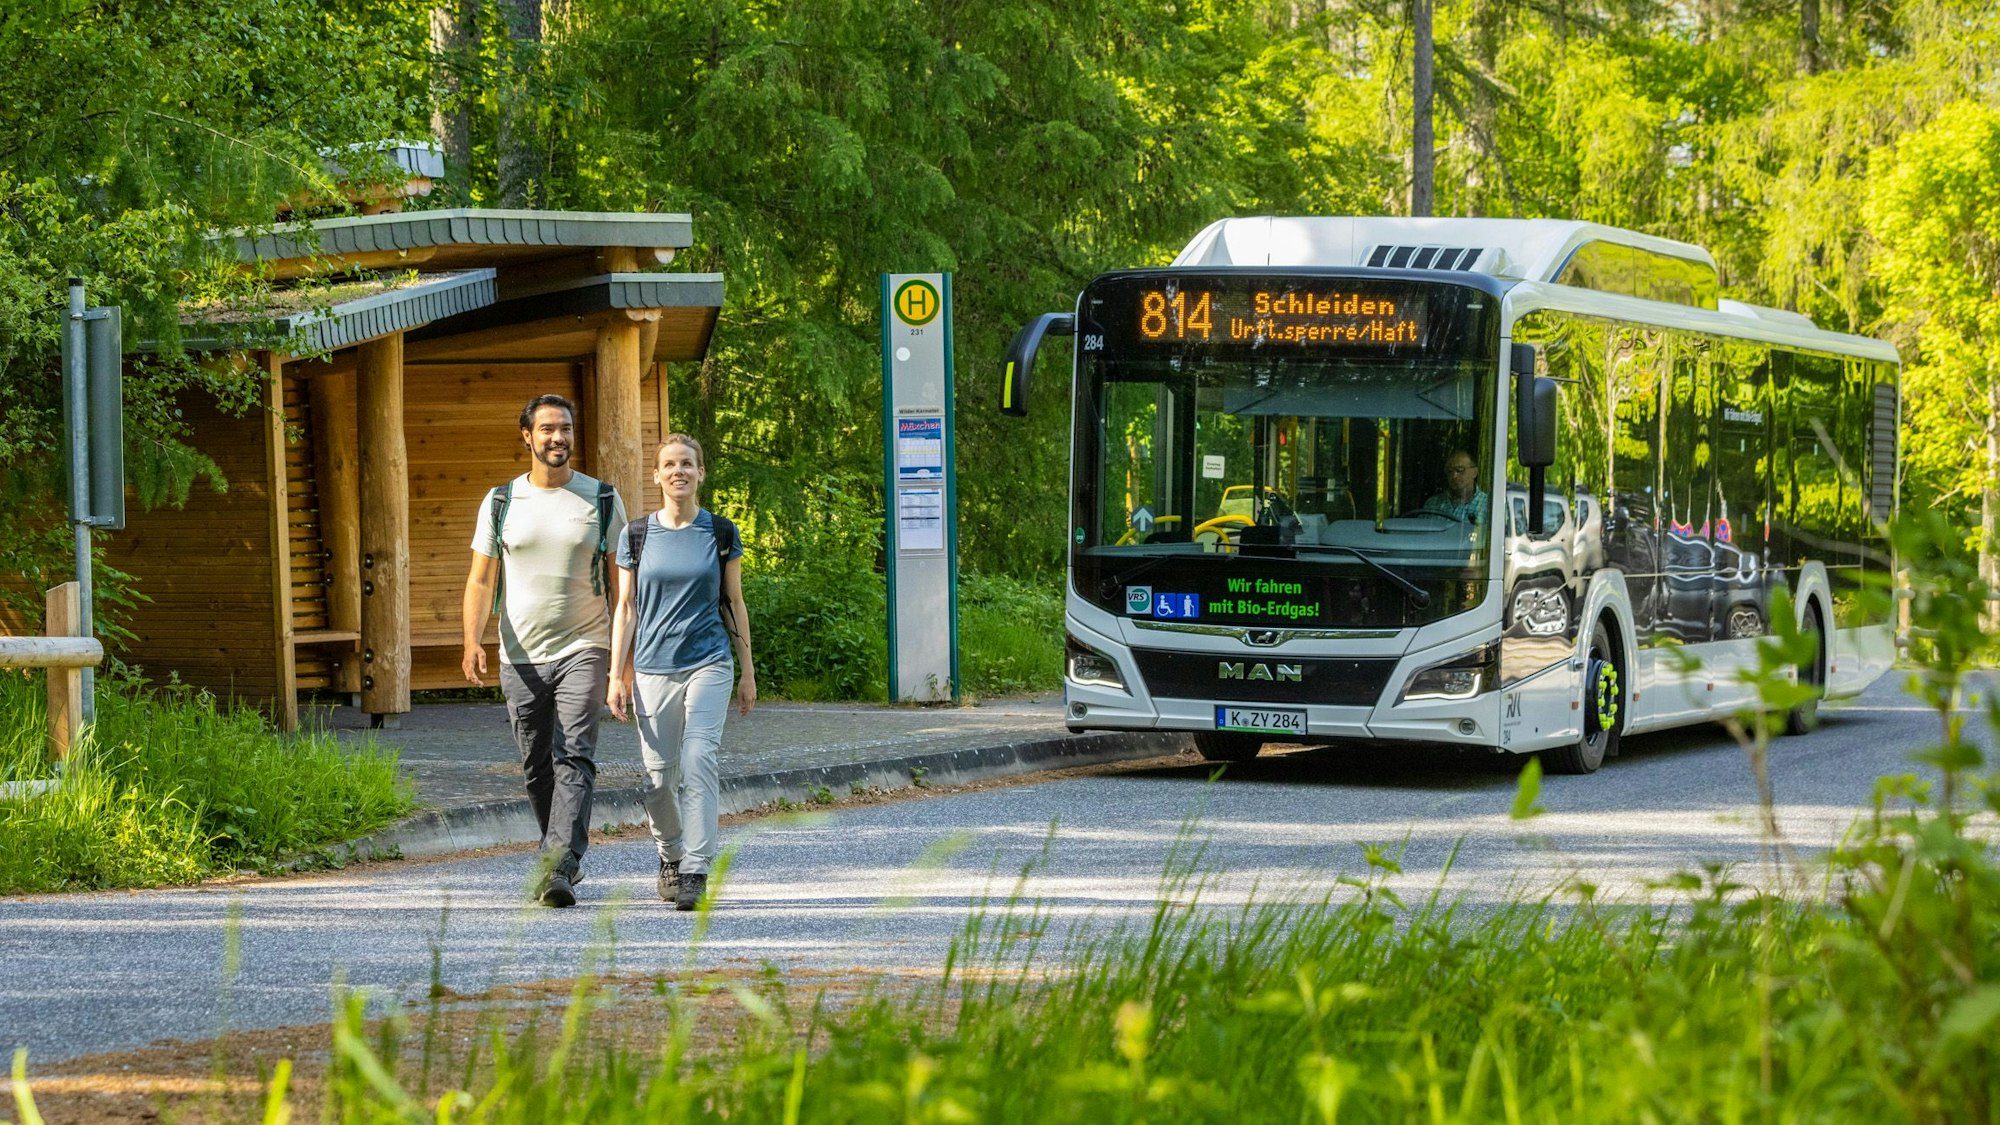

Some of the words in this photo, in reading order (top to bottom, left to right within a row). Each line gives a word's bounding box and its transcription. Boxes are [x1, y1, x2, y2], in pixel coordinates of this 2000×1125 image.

[908, 289, 925, 315] H
[1255, 292, 1395, 316] Schleiden
[1141, 291, 1212, 338] 814
[910, 328, 924, 336] 231
[1231, 318, 1418, 342] Urft.sperre/Haft
[1084, 334, 1104, 351] 284
[1128, 592, 1145, 601] VRS
[1227, 578, 1252, 593] Wir
[1255, 579, 1302, 594] fahren
[1209, 599, 1234, 614] mit
[1237, 601, 1320, 620] Bio-Erdgas!
[1218, 661, 1303, 682] MAN
[1231, 711, 1241, 726] K
[1250, 712, 1269, 727] ZY
[1272, 713, 1300, 729] 284
